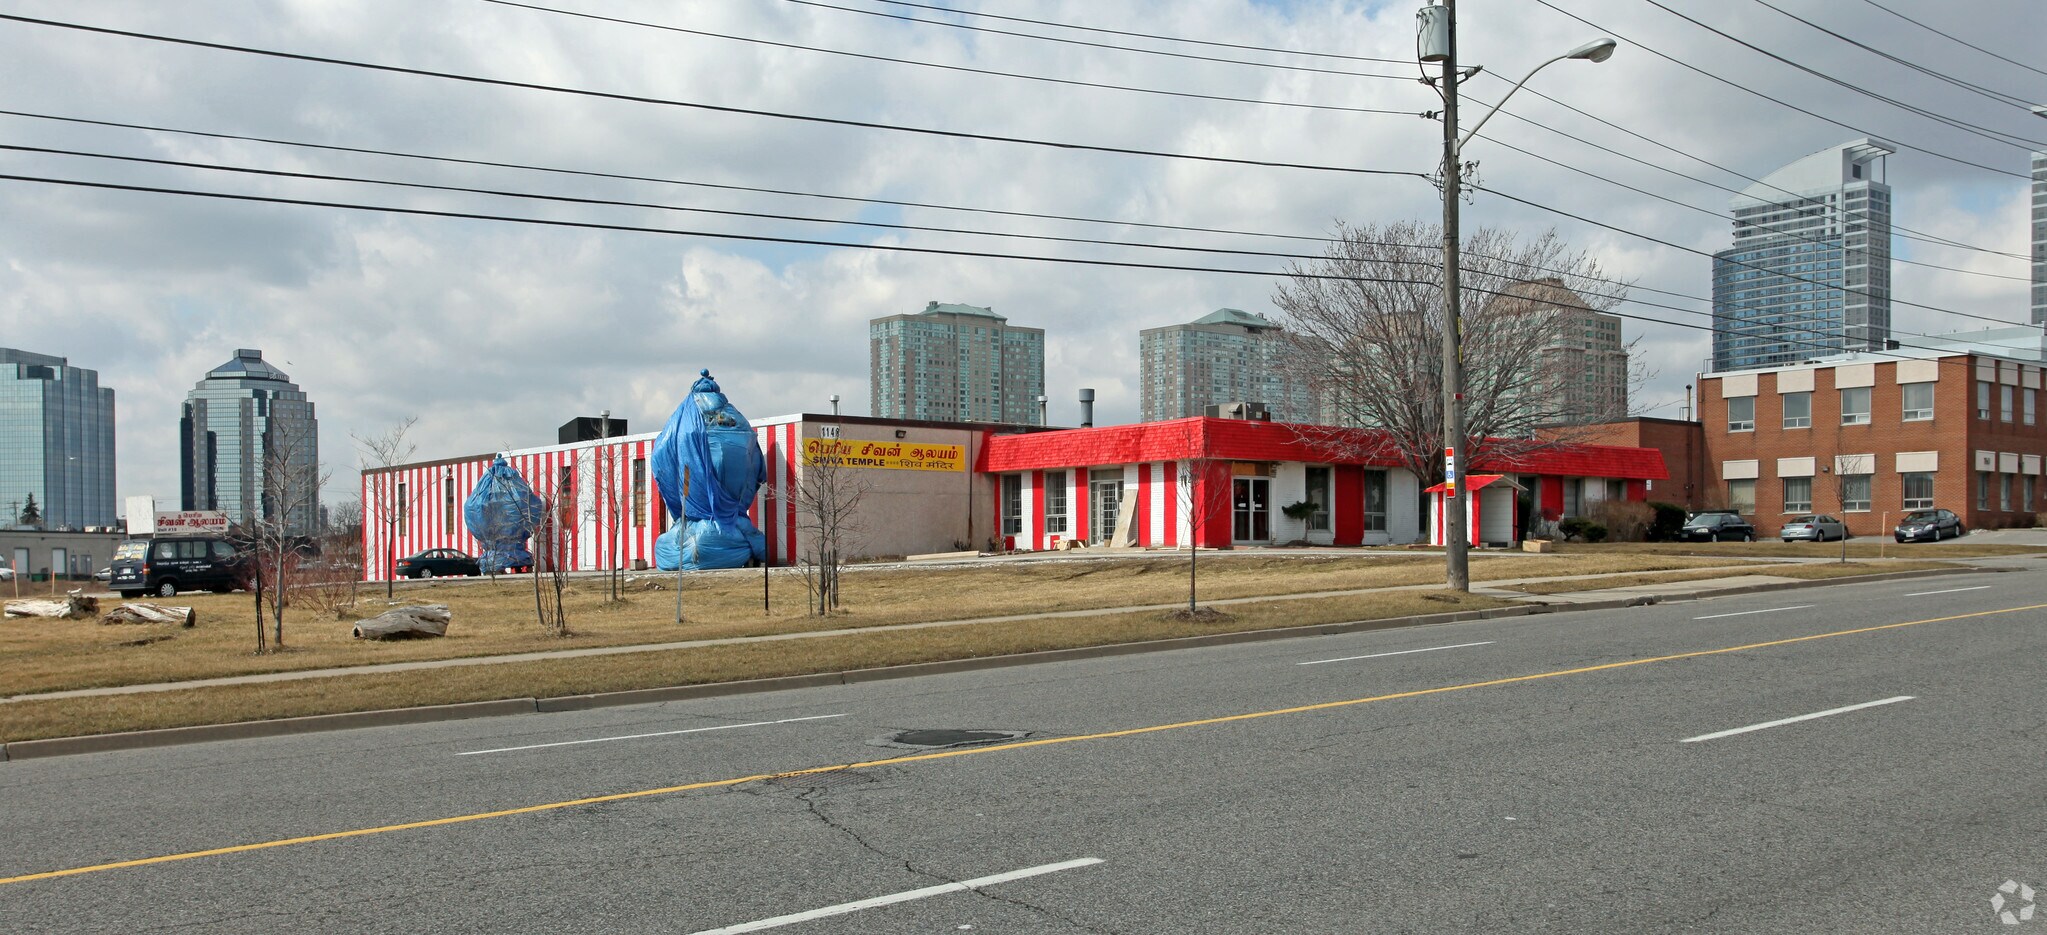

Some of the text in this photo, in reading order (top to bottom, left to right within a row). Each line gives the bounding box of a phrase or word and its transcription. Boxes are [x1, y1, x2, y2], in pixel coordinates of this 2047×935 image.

[822, 427, 840, 437] 1148
[861, 443, 901, 457] சிவன்
[910, 445, 958, 460] ஆலயம்
[813, 456, 885, 466] SHIVA TEMPLE
[899, 458, 955, 470] शिव मंदिर
